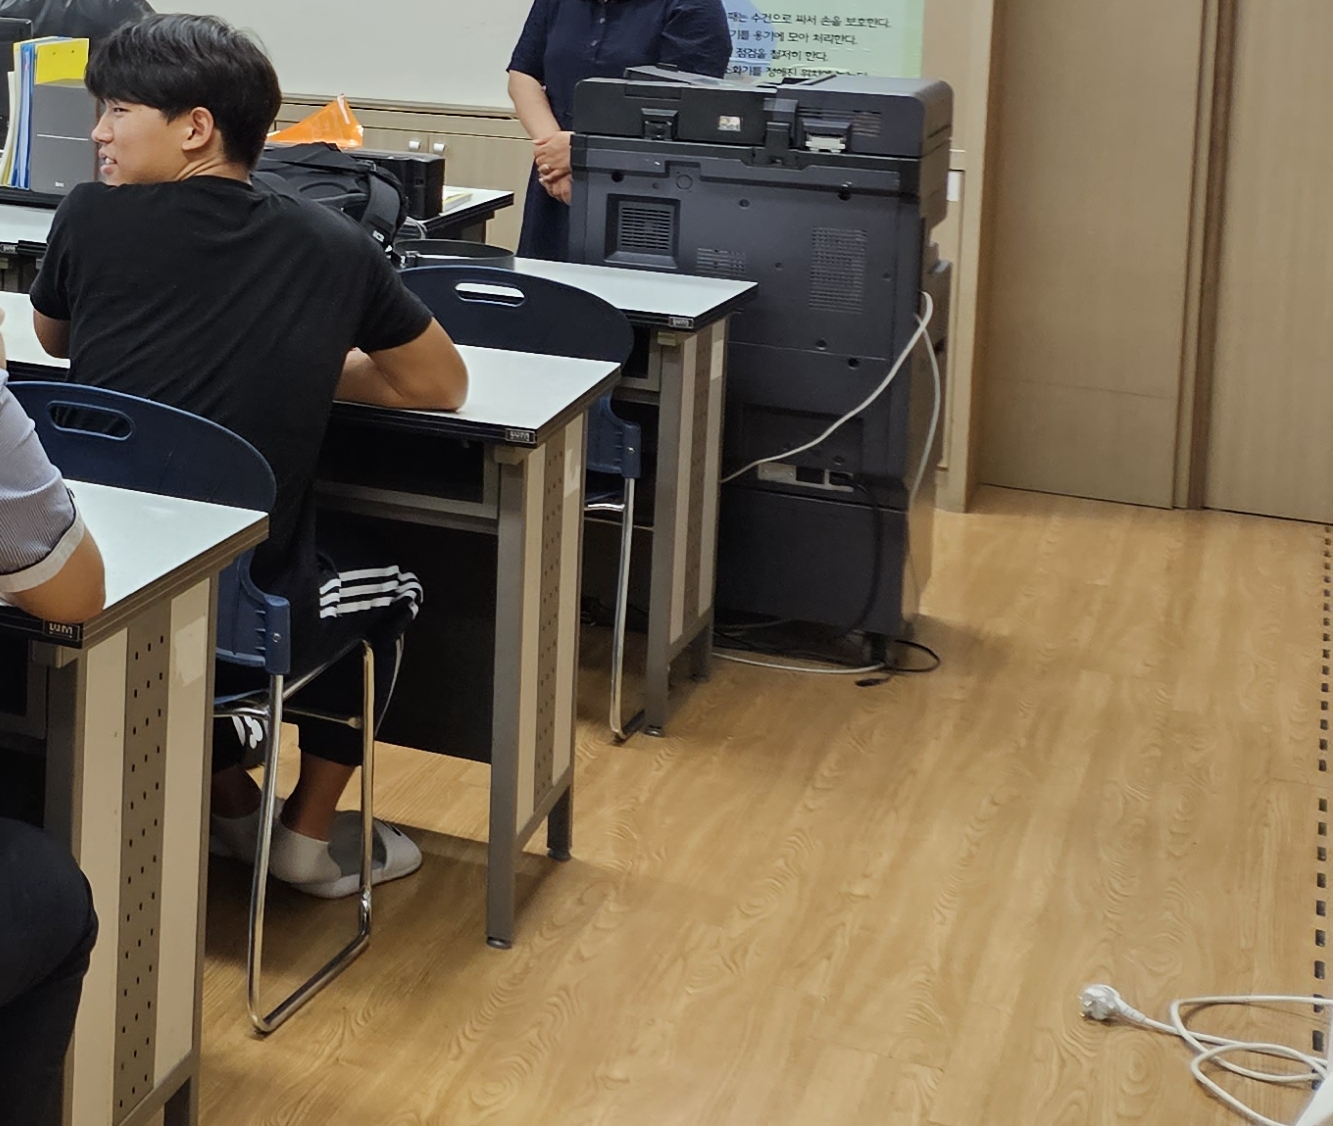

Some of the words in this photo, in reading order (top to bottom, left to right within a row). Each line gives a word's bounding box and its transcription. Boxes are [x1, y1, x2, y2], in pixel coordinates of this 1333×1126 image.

[751, 13, 792, 24] 수건으로
[820, 16, 842, 27] 손을
[845, 18, 891, 28] 보호한다.
[754, 30, 785, 42] 용기에
[788, 32, 809, 43] 모아
[813, 34, 858, 45] 처리한다.
[736, 48, 766, 59] 점검을
[772, 49, 802, 61] 철저히
[805, 51, 829, 62] 한다.
